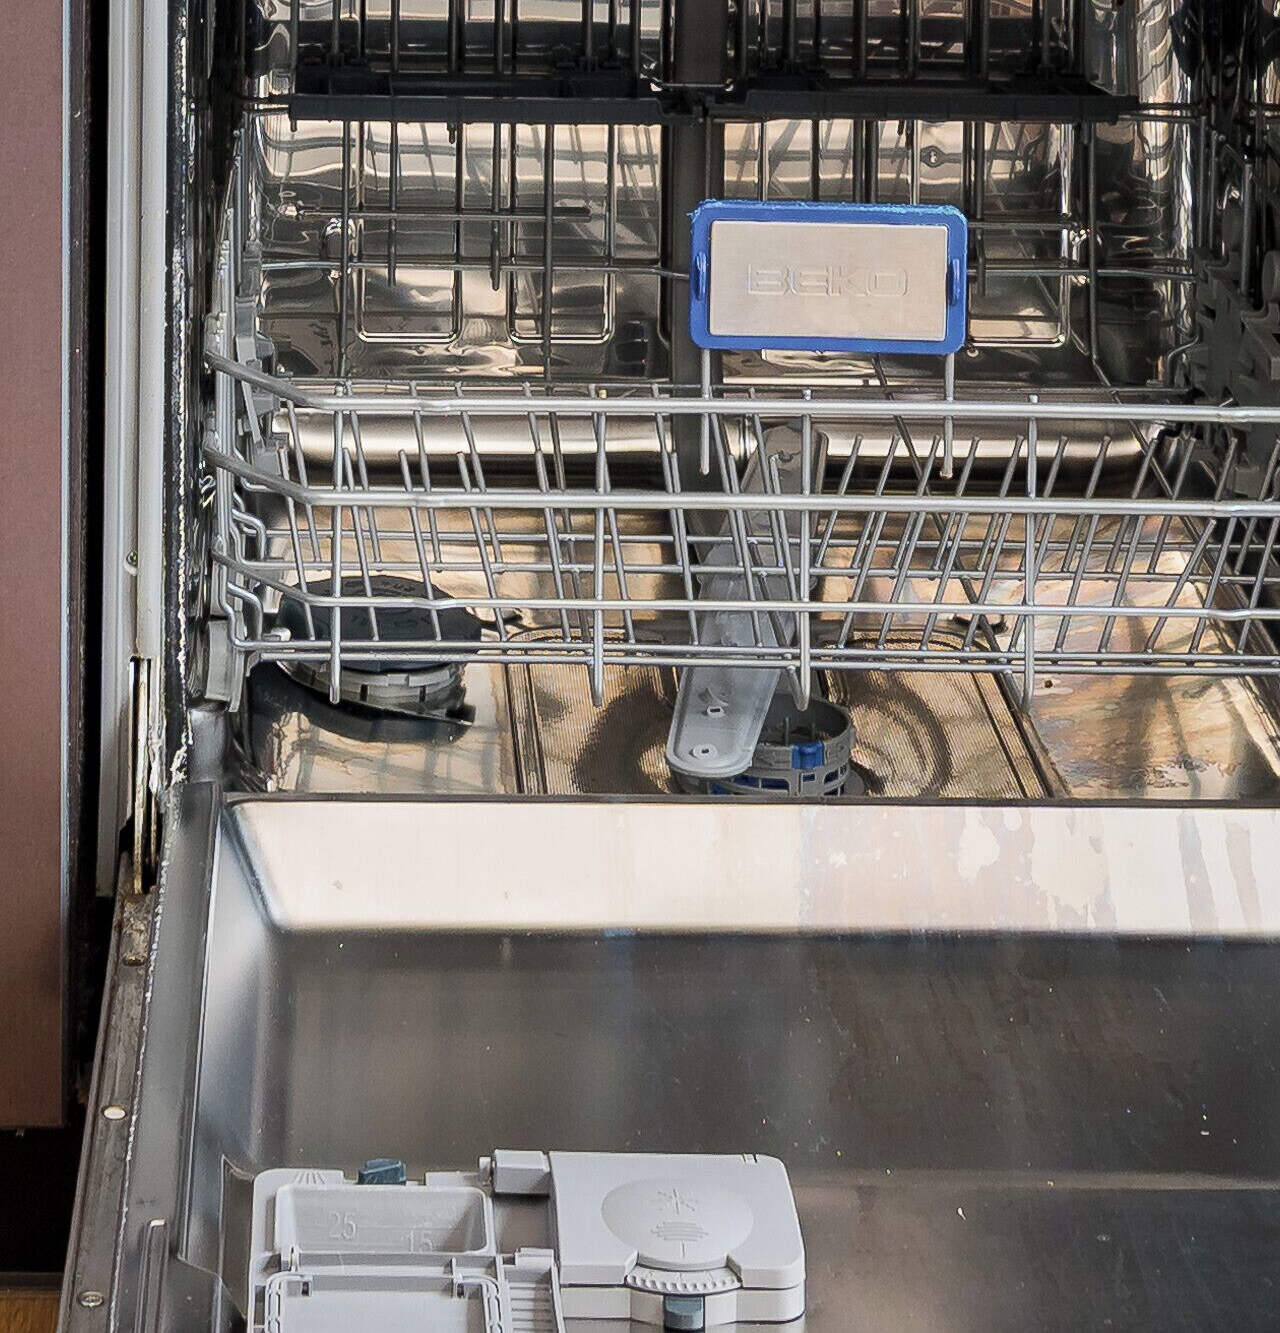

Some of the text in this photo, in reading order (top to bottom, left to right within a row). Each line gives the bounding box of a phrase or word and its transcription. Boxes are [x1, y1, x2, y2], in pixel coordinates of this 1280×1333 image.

[747, 263, 909, 298] BEKO
[327, 1210, 357, 1240] 25
[405, 1229, 434, 1254] 15
